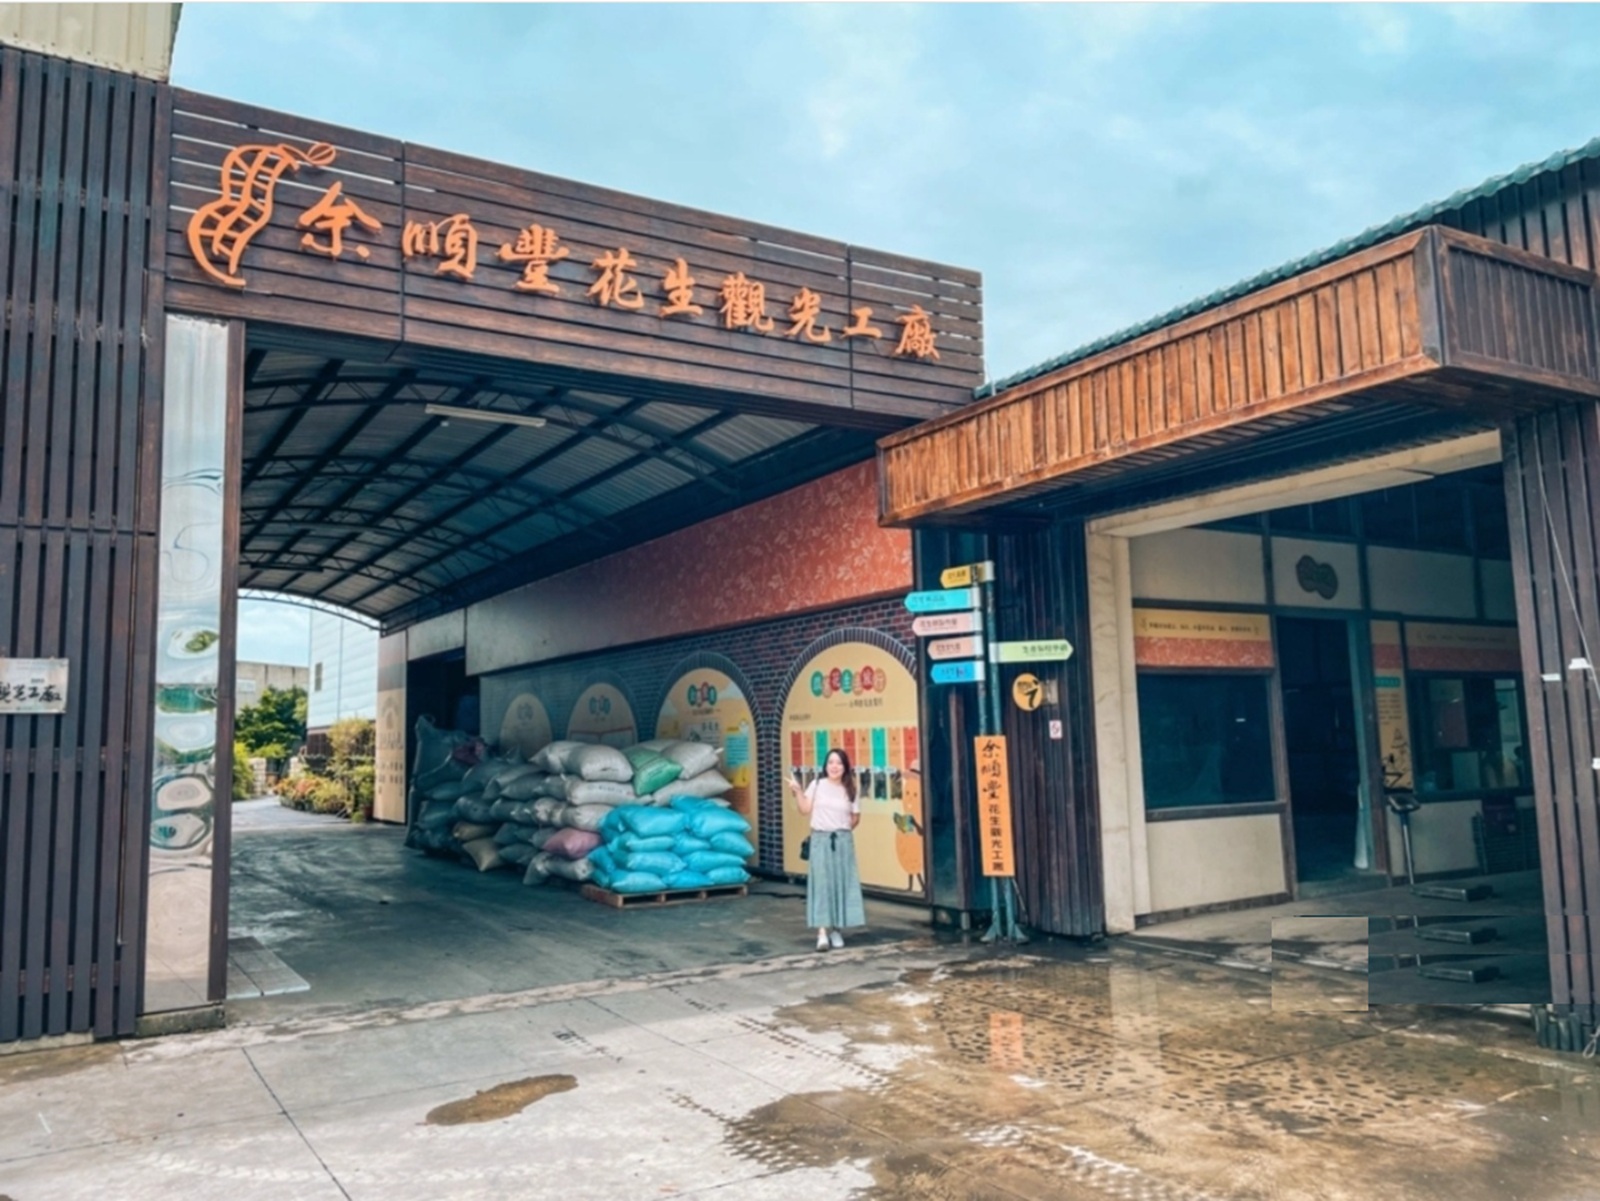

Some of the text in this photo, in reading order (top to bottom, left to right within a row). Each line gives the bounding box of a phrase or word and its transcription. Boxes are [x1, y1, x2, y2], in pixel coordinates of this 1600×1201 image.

[298, 180, 941, 362] 余順豐花生觀光工廠
[981, 739, 1004, 871] 余順豐花生觀光工廠
